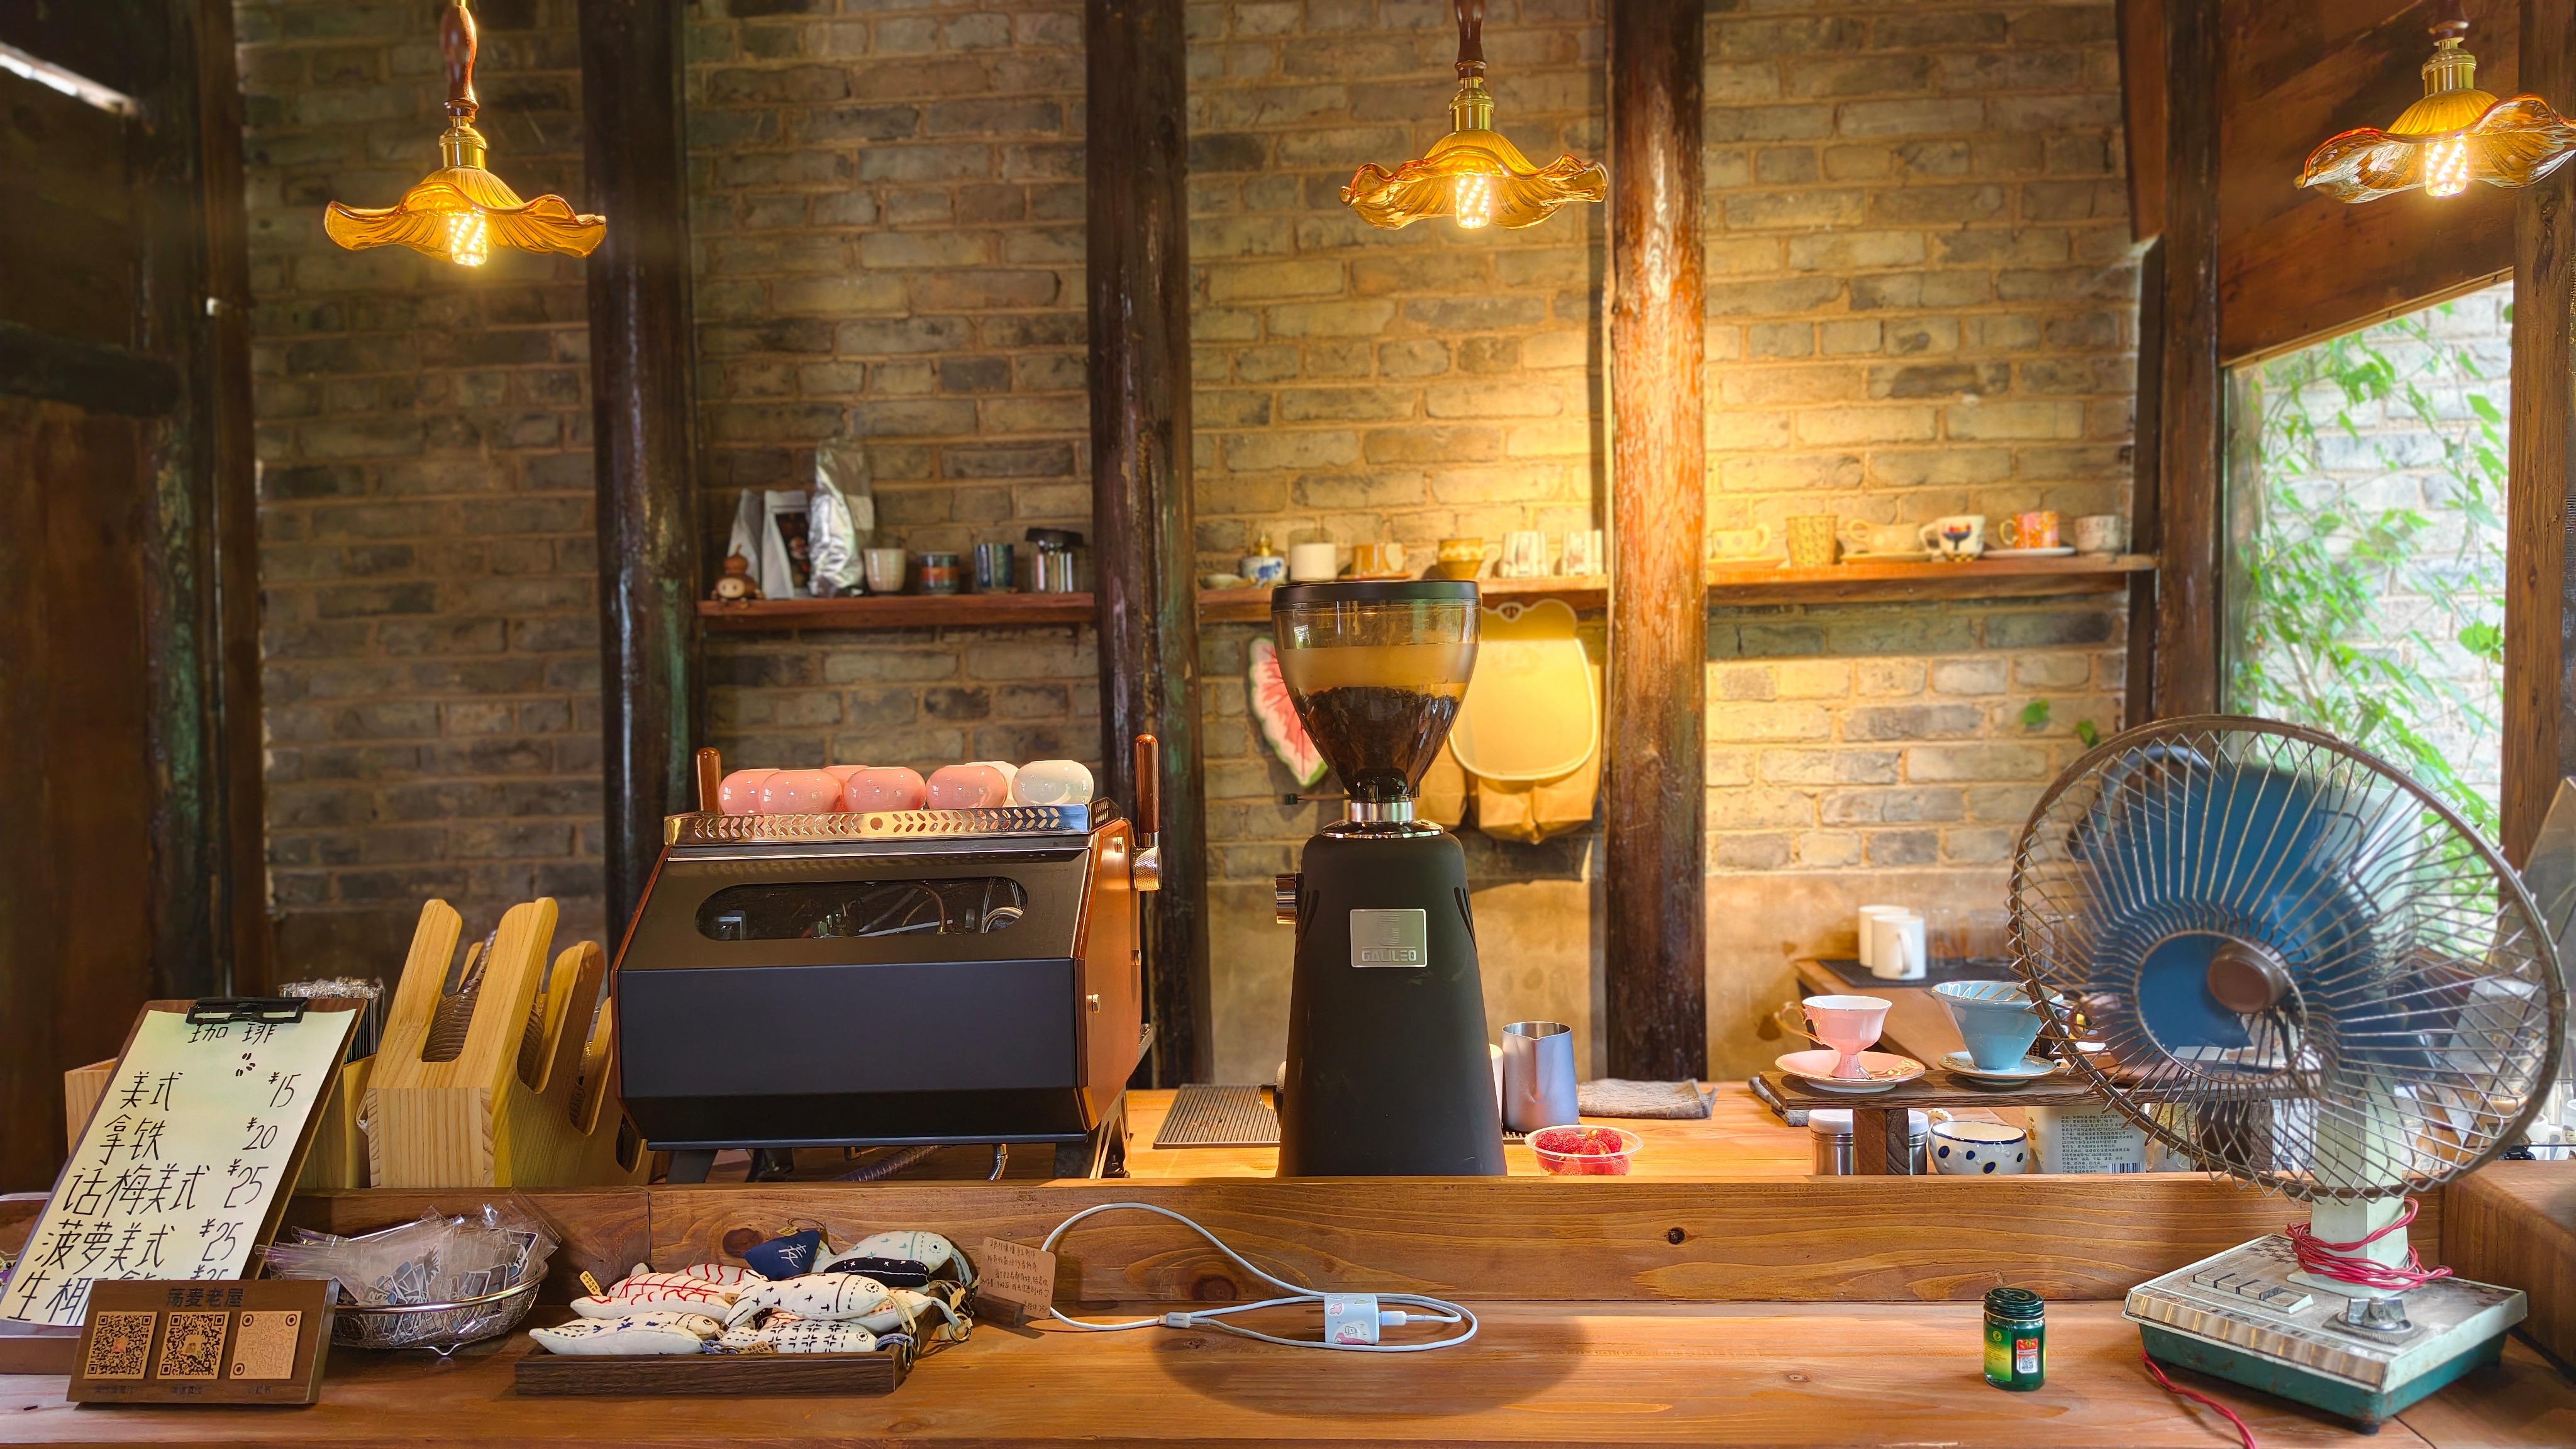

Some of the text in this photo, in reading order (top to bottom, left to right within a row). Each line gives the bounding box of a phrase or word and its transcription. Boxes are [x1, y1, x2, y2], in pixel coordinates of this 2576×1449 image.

[1362, 949, 1417, 962] GALILEO
[120, 1071, 301, 1111] 美式 ¥15
[99, 1114, 278, 1165] 拿铁 ¥20
[62, 1159, 269, 1218] 话梅美式 ¥25
[34, 1218, 244, 1275] 菠萝美式 ¥25
